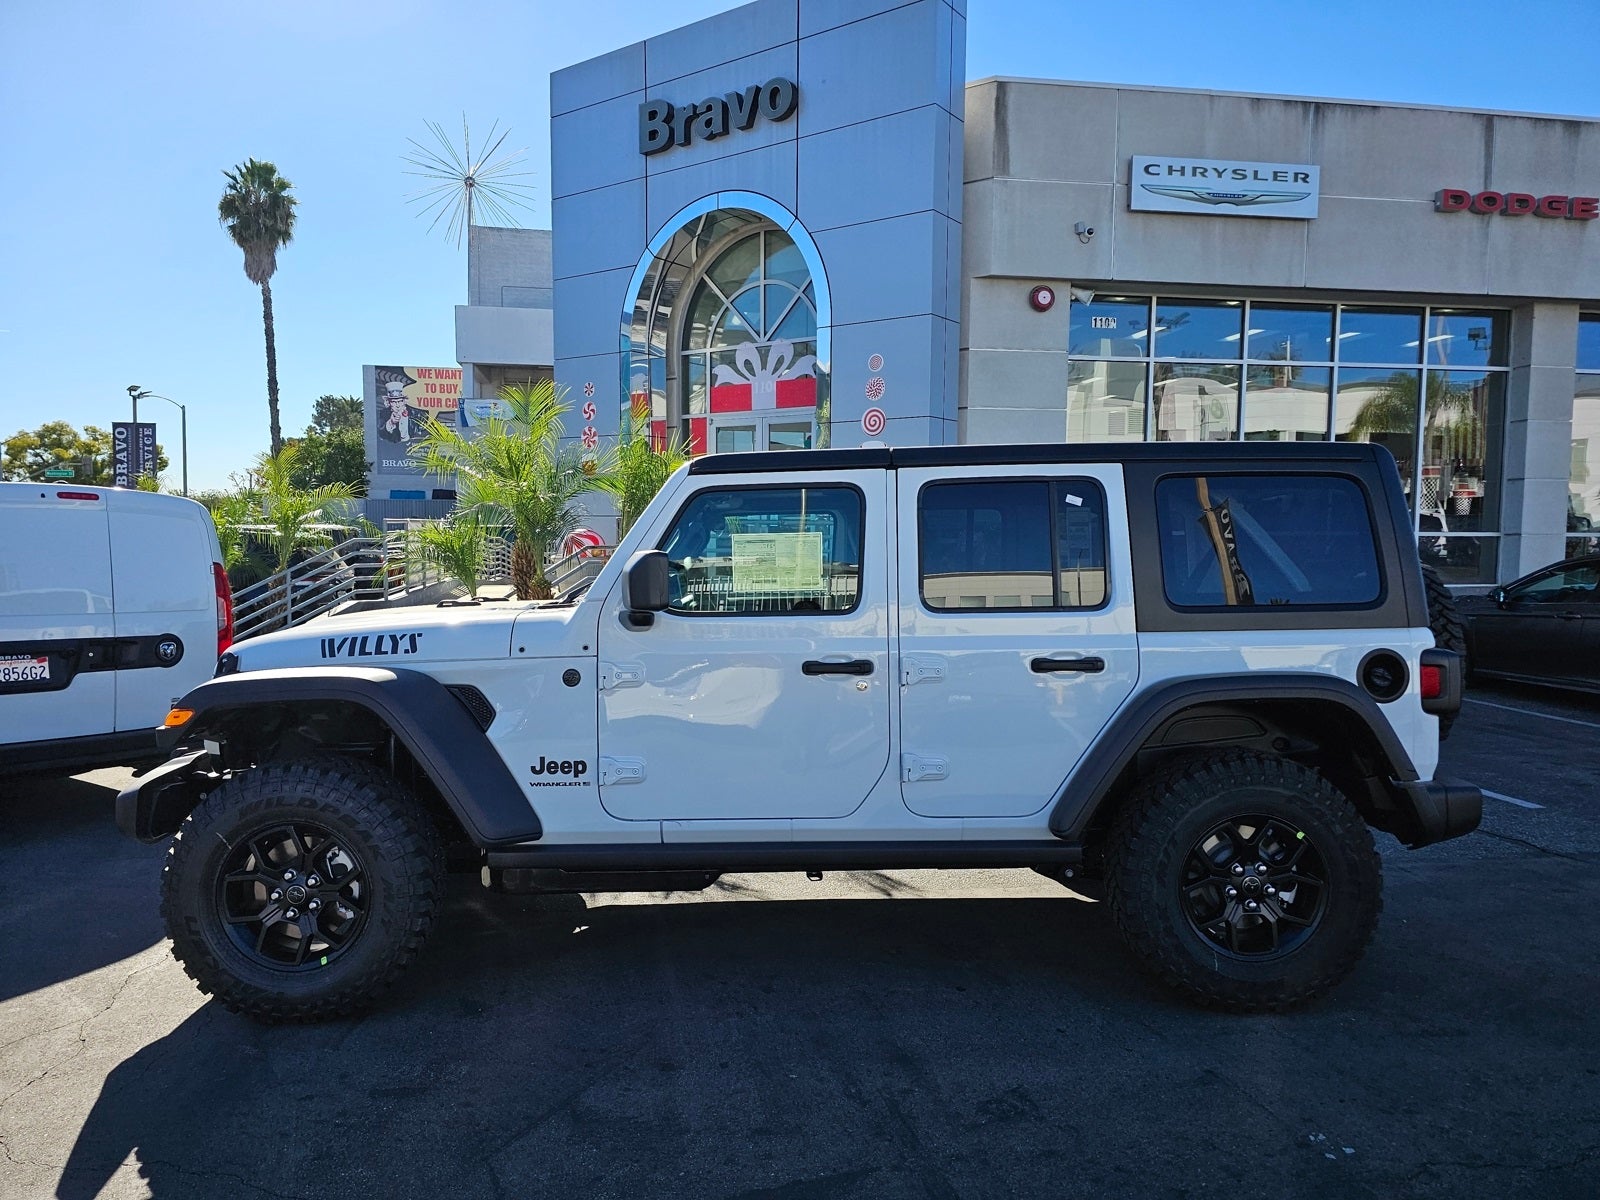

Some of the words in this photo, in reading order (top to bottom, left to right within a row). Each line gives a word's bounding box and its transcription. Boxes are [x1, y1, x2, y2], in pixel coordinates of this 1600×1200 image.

[639, 77, 798, 155] Bravo
[1143, 163, 1310, 184] CHRYSLER
[1436, 189, 1599, 220] DODGE
[417, 368, 432, 379] WE
[433, 368, 462, 380] WANT
[424, 383, 437, 394] TO
[439, 383, 458, 394] BUY
[417, 397, 442, 408] YOUR
[445, 398, 458, 409] CA
[115, 427, 128, 486] BRAVO
[143, 427, 154, 477] ERVICE
[382, 459, 417, 468] BRAVO
[321, 633, 423, 658] WILLYS
[0, 665, 47, 681] 856G2
[530, 756, 587, 778] Jeep
